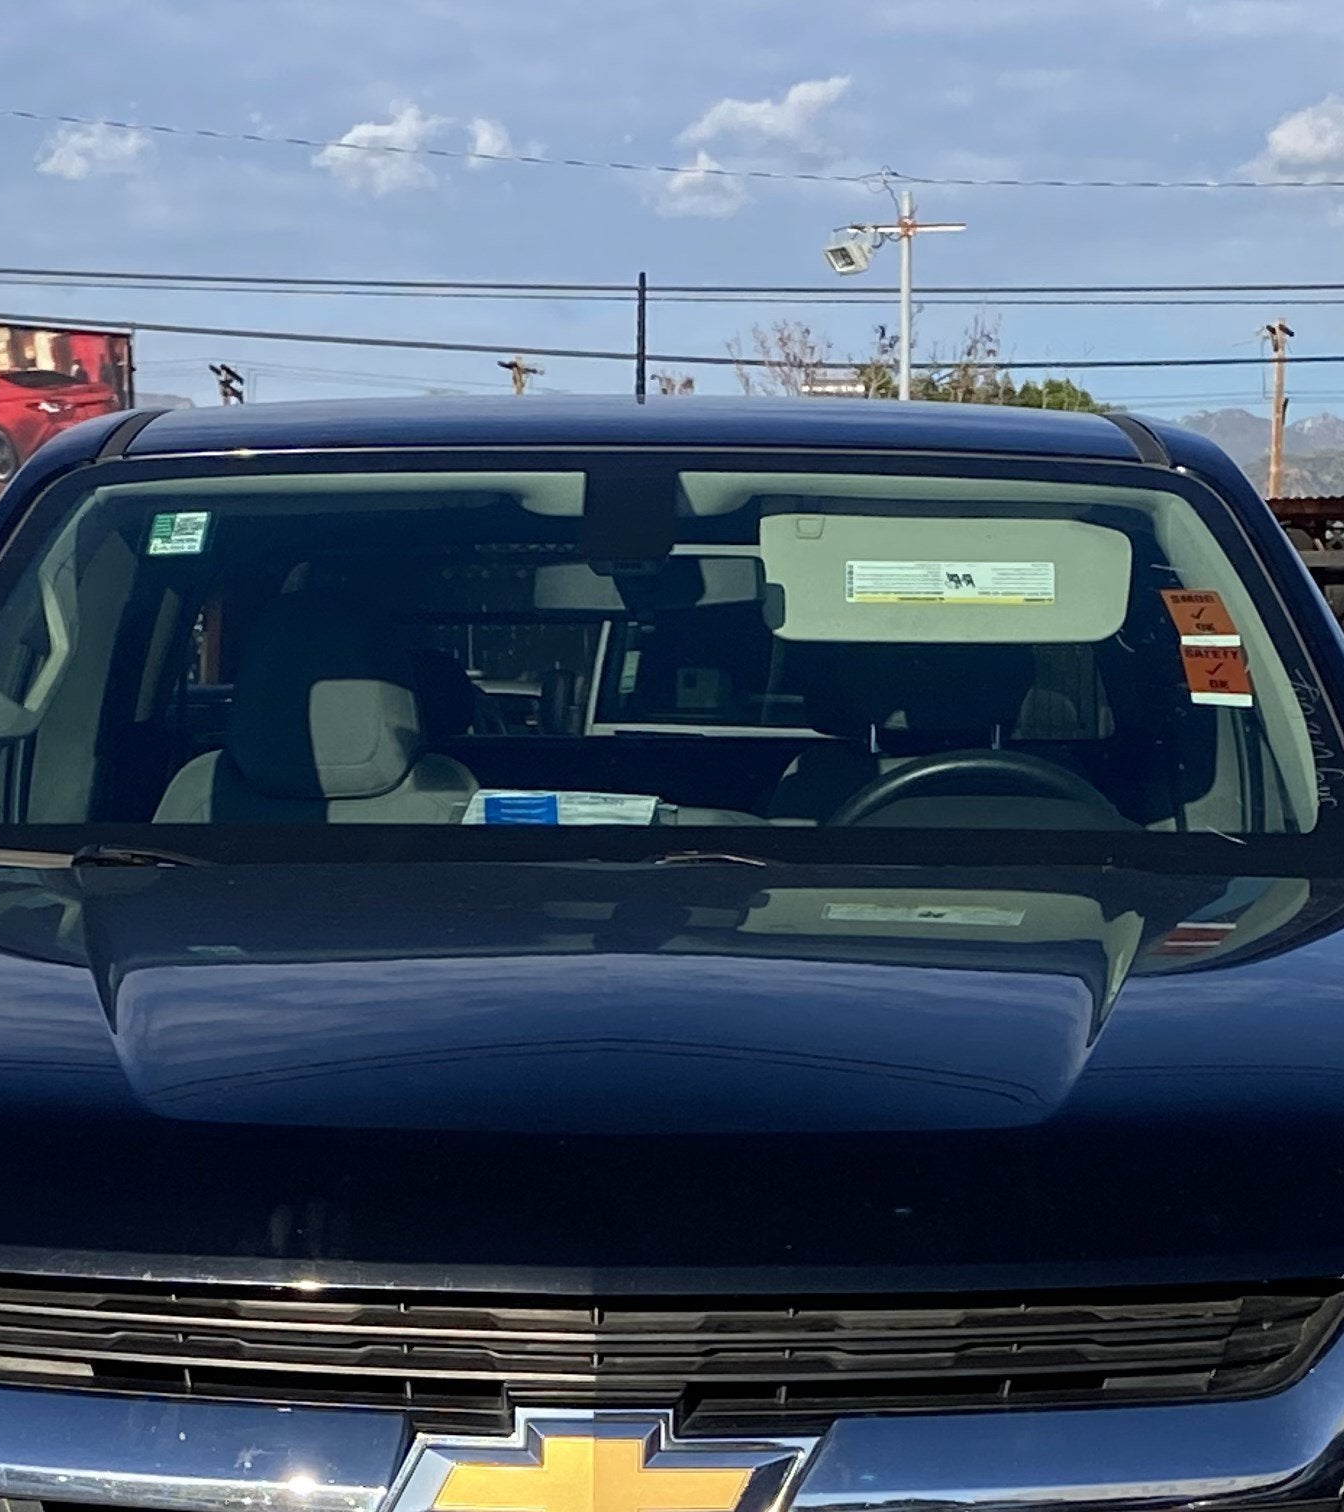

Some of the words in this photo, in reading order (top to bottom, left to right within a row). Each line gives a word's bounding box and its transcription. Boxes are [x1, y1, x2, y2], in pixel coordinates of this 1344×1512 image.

[1195, 622, 1216, 632] OK
[1183, 648, 1239, 660] SAFETY
[1209, 679, 1230, 689] OK
